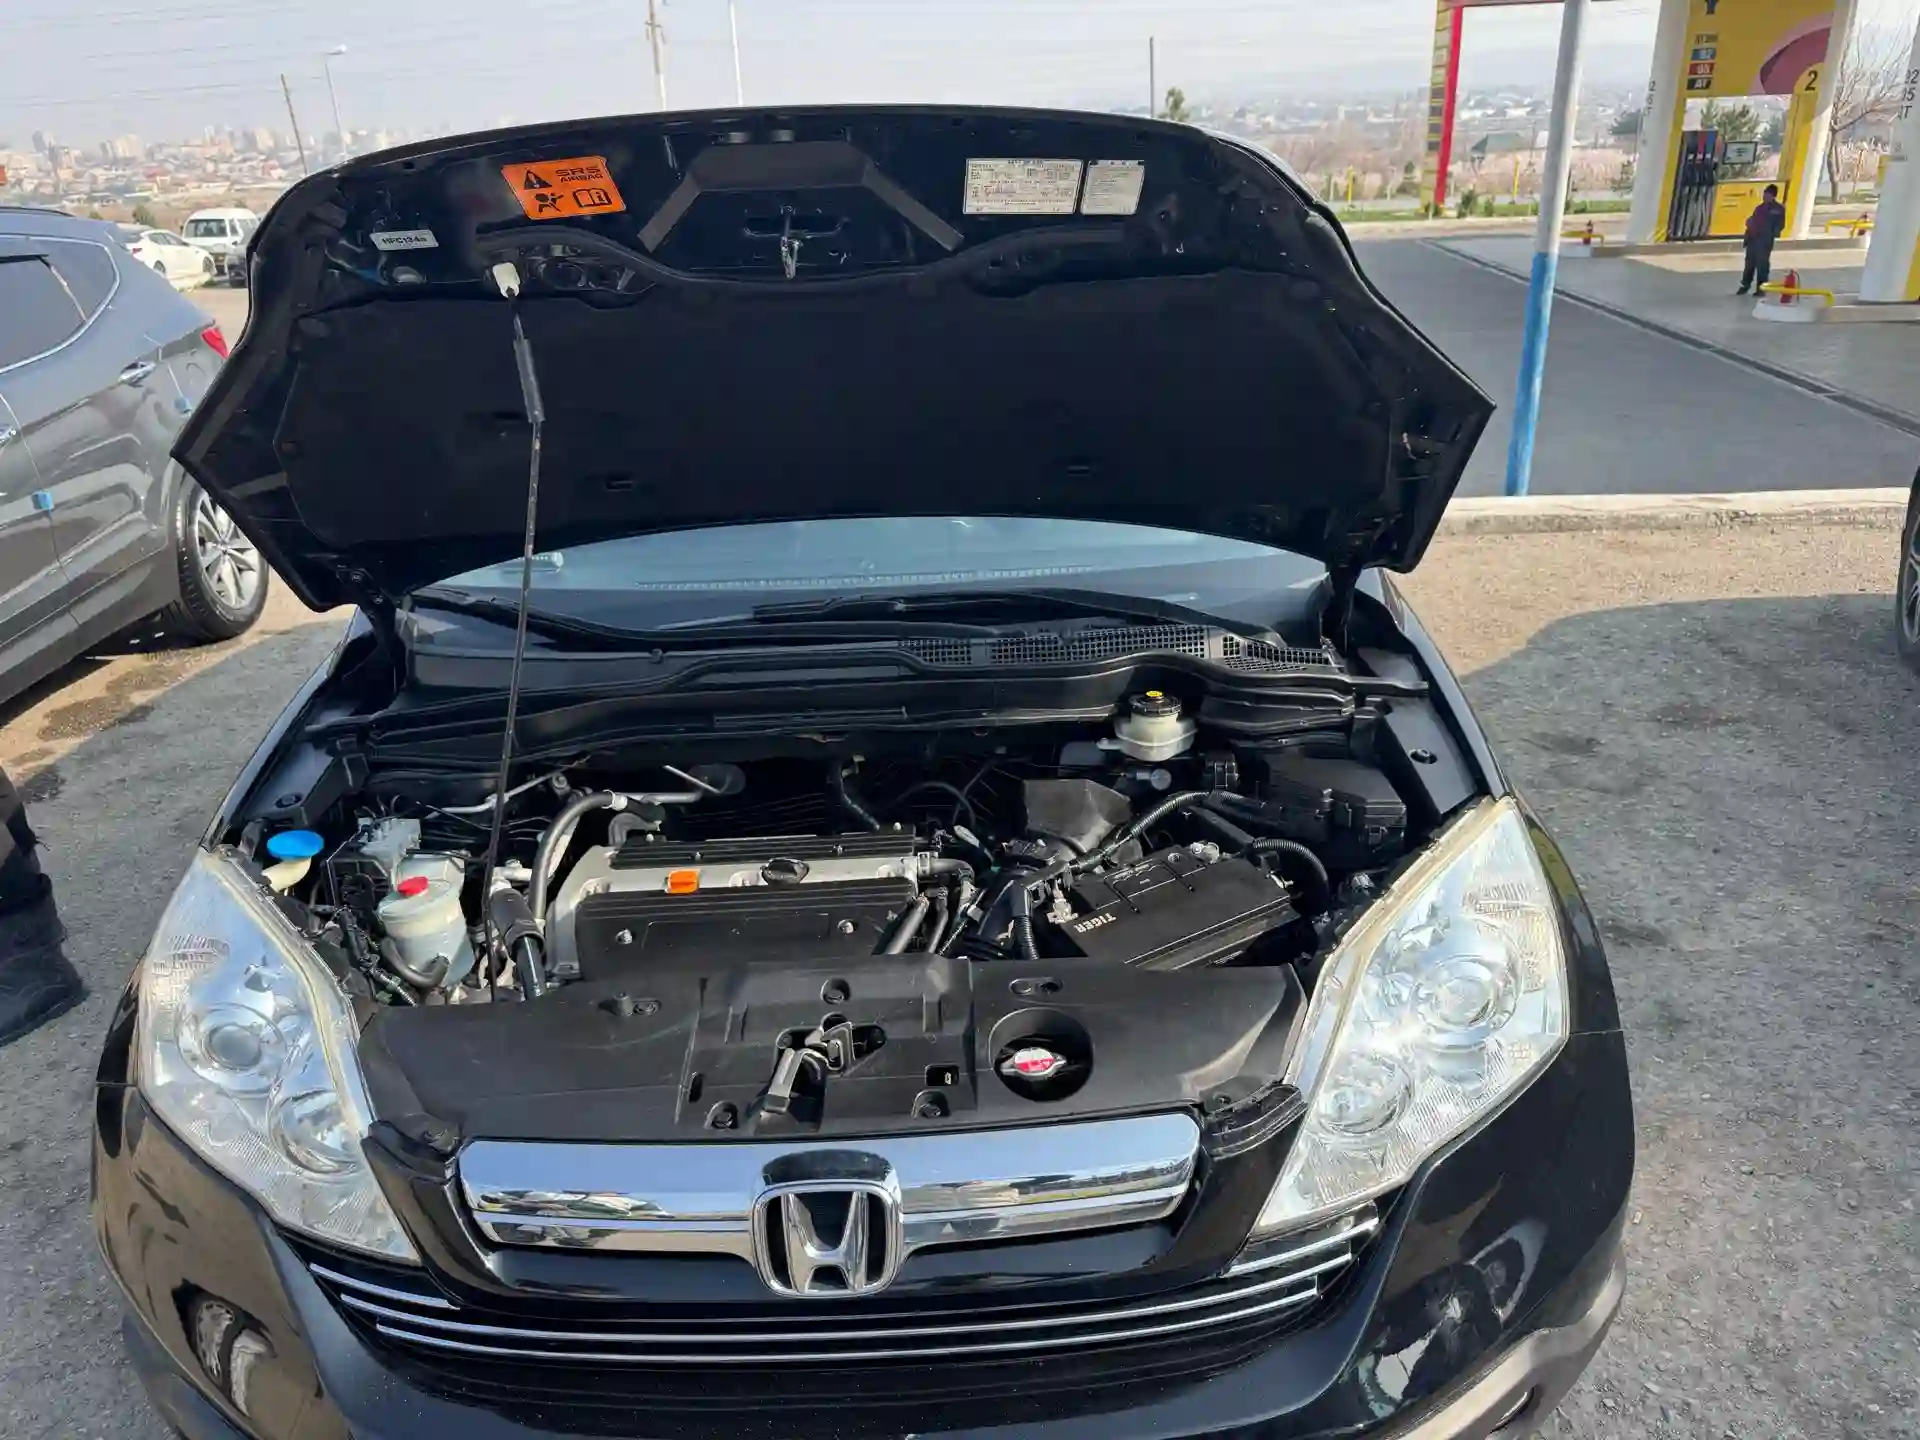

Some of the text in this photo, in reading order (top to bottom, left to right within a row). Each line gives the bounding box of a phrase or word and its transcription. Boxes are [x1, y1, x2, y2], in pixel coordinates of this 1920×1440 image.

[1804, 70, 1818, 91] 2
[556, 166, 601, 176] SRS
[1073, 912, 1117, 933] TIGER
